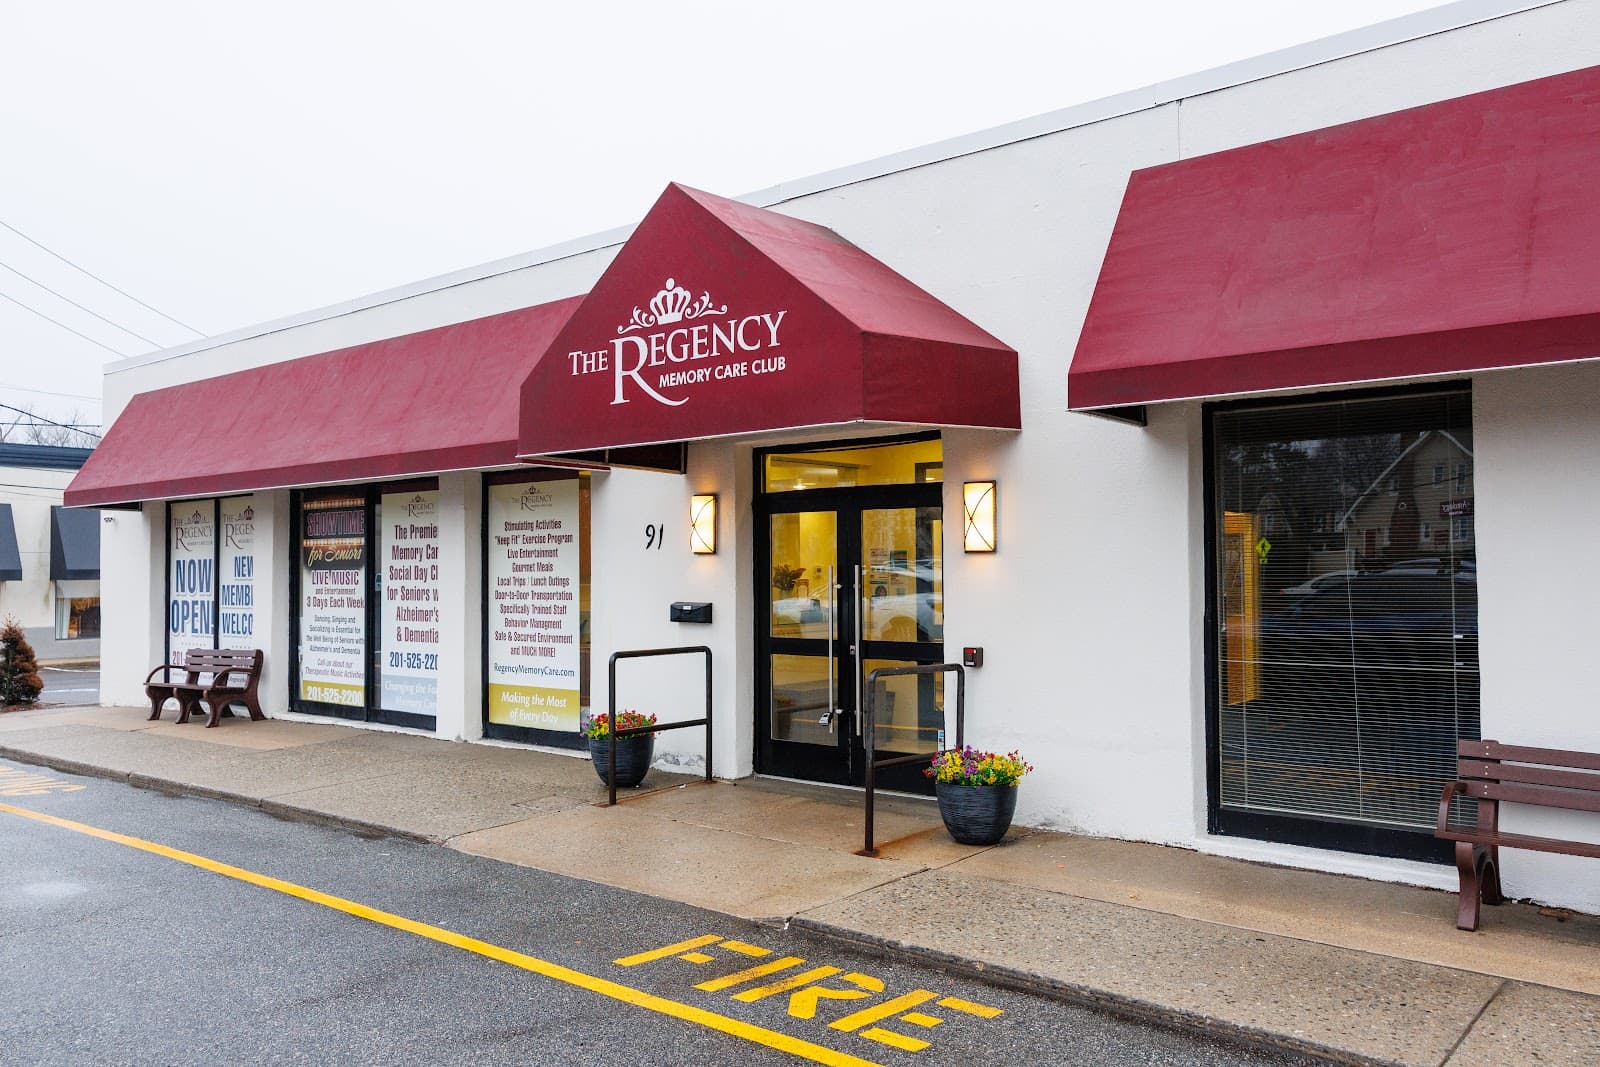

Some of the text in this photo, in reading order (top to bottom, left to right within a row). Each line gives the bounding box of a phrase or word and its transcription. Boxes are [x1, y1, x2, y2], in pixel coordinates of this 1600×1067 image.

[568, 310, 787, 407] THE REGENCY
[659, 356, 786, 388] MEMORY CARE CLUB
[409, 503, 435, 518] REGENCY
[521, 494, 553, 512] REGENCY
[308, 511, 364, 536] SHOWTIME
[505, 519, 562, 532] Stimulating Activities
[175, 525, 213, 552] REGENCY
[395, 525, 408, 541] The
[523, 534, 547, 545] Exercise
[548, 533, 573, 545] Program
[645, 523, 664, 550] 91
[309, 545, 362, 567] for Seniors
[392, 545, 424, 562] Memory
[508, 547, 558, 559] Live Entertainment
[390, 565, 412, 581] Social
[415, 565, 428, 583] Day
[512, 561, 554, 573] Gourmet Meals
[175, 558, 213, 594] NOW
[312, 569, 360, 586] LIVE MUSIC
[498, 576, 511, 586] Local
[513, 576, 526, 588] Trips
[531, 577, 547, 587] Lunch
[549, 576, 570, 588] Outings
[325, 587, 357, 596] Entertainment
[388, 586, 399, 601] for
[401, 586, 431, 602] Seniors
[495, 590, 573, 601] Door-to-Door Transportation
[307, 597, 312, 608] 3
[314, 597, 328, 610] Days
[330, 597, 345, 608] Each
[500, 603, 567, 615] Specifically Trained Staff
[505, 617, 528, 628] Behavior
[397, 626, 439, 643] & Dementia
[495, 631, 573, 644] Safe & Secured Environment
[511, 646, 556, 658] and MUCH MORE!
[495, 662, 575, 677] RegencyMemoryCare.com
[308, 685, 363, 705] 201-525-2200
[502, 692, 567, 708] Making the Most
[511, 708, 559, 723] of Every Day
[613, 934, 1006, 1053] FIRE
